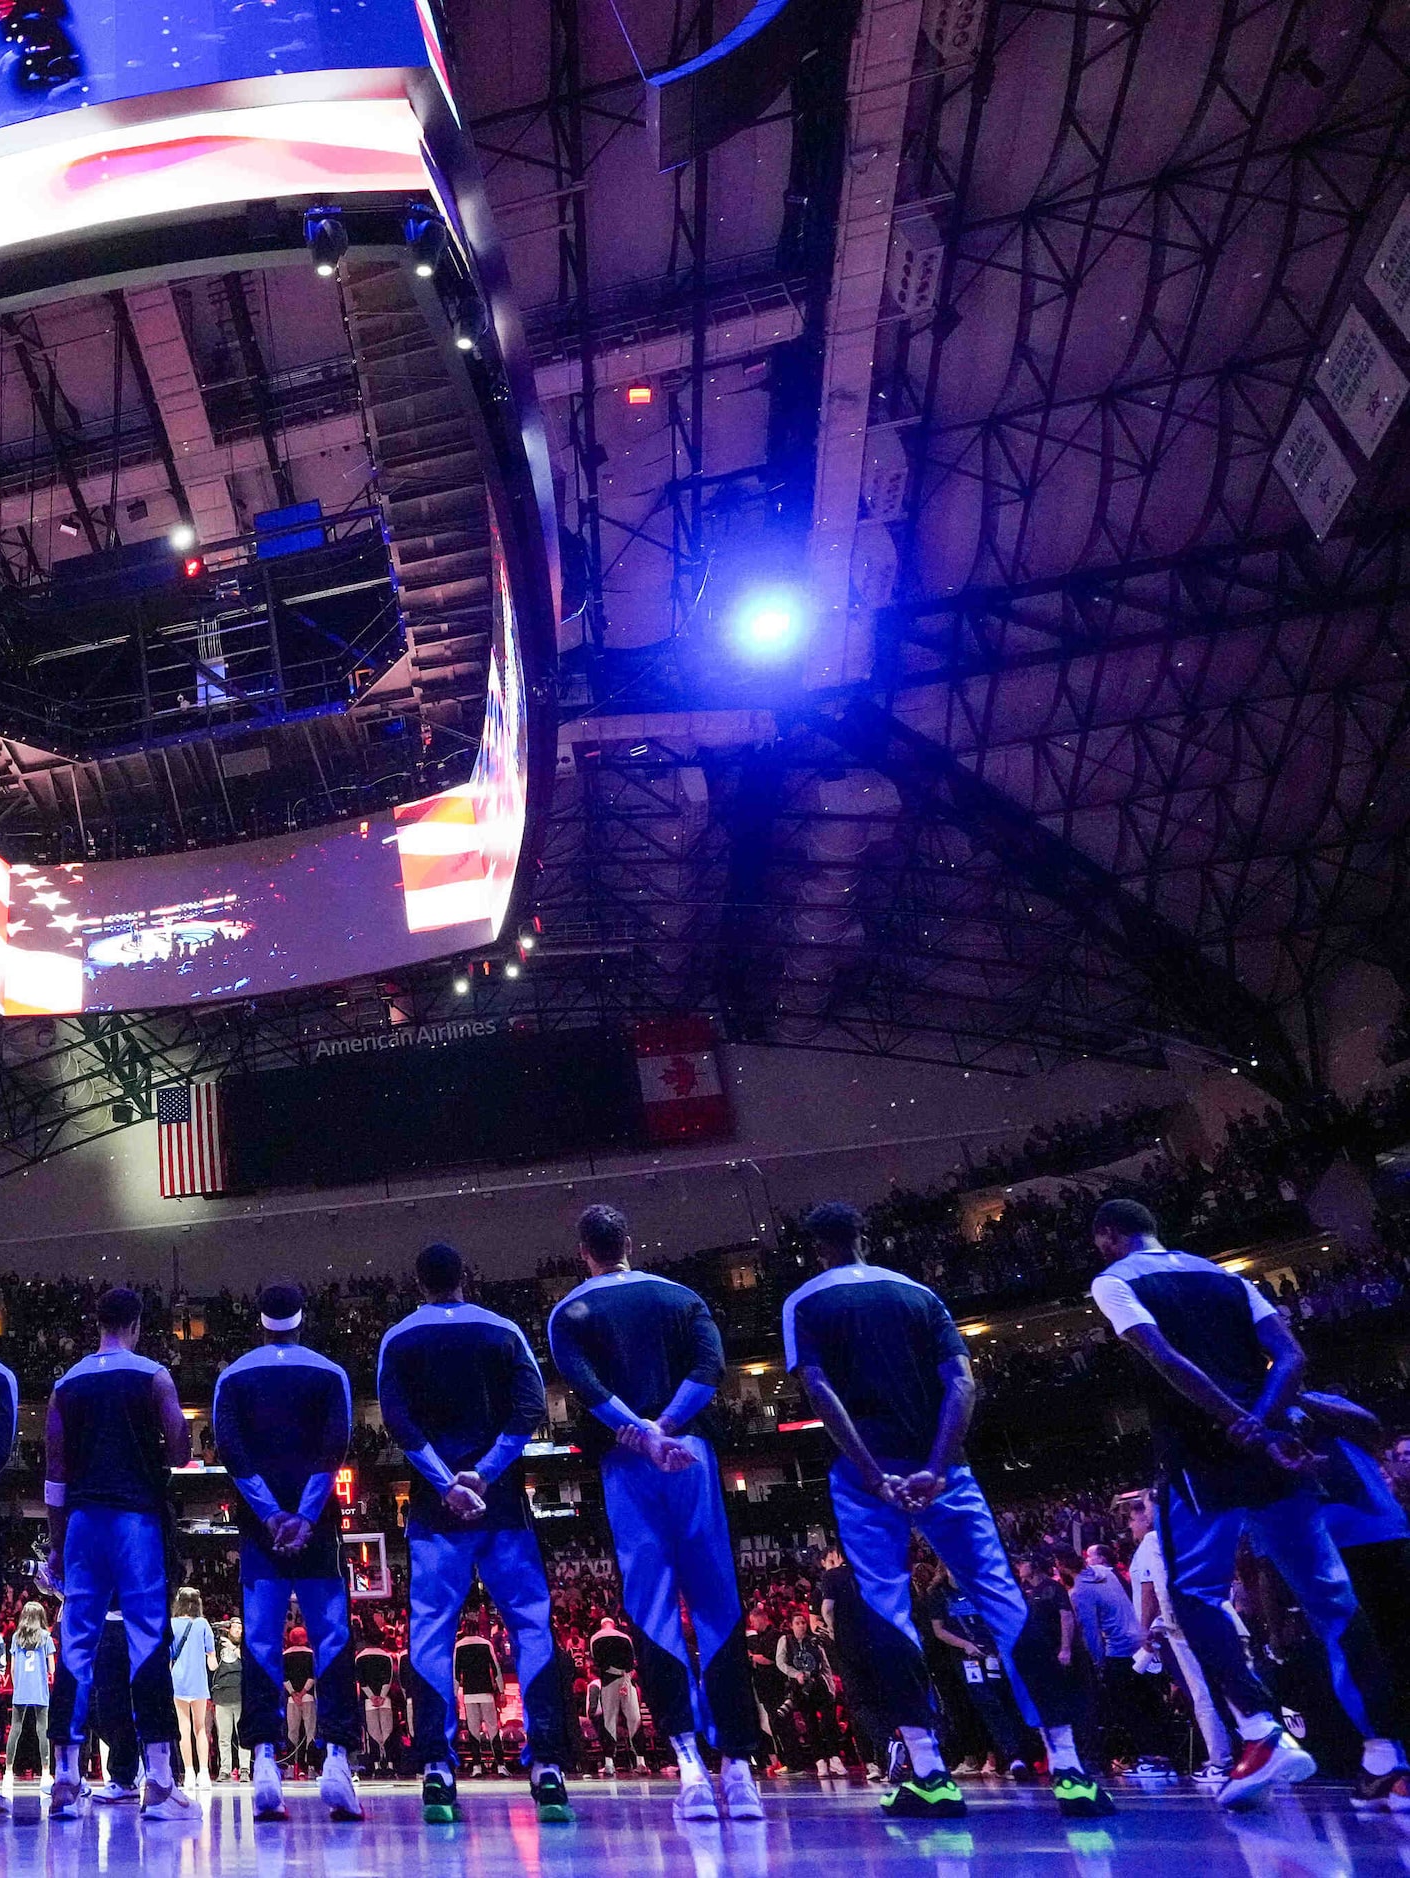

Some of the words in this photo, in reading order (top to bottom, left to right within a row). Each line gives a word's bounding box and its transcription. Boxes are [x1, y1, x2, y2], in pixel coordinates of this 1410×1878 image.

[316, 1032, 413, 1057] American
[417, 1020, 497, 1043] Airlines
[24, 1650, 36, 1672] 2
